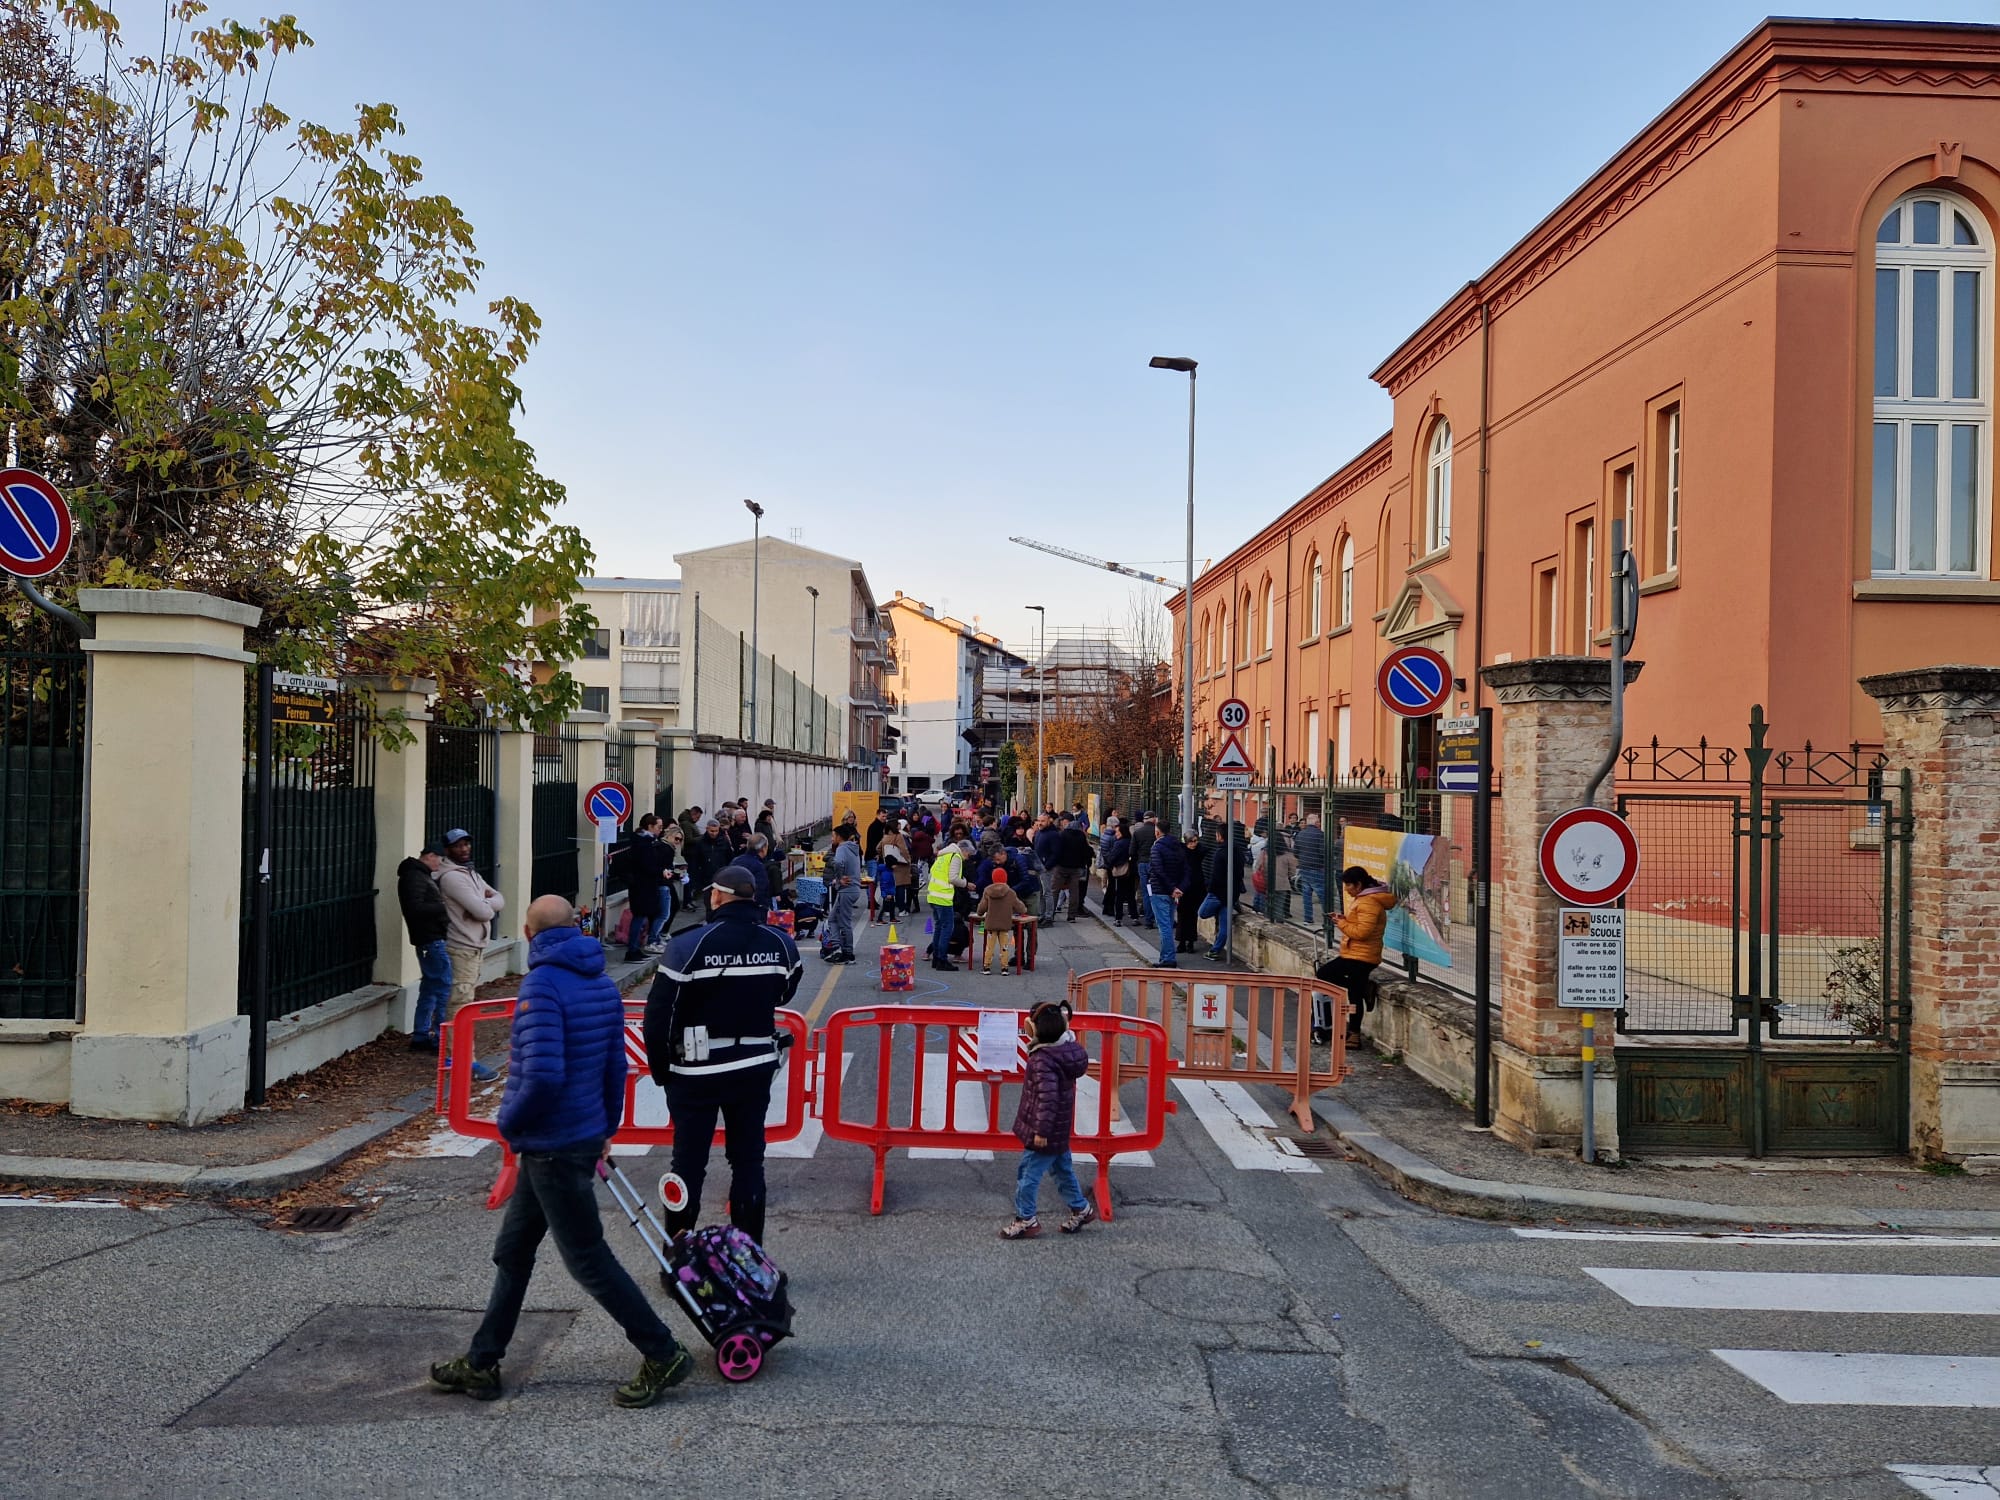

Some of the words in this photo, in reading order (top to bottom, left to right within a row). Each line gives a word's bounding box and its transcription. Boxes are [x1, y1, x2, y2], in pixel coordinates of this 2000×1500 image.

[307, 679, 312, 687] DI
[314, 680, 328, 688] ALBA
[286, 706, 310, 720] Ferrero
[1224, 707, 1244, 722] 30
[1590, 915, 1622, 924] USCITA
[1590, 928, 1621, 937] SCUOLE
[704, 954, 743, 966] POLIZIA
[746, 952, 780, 965] LOCALE
